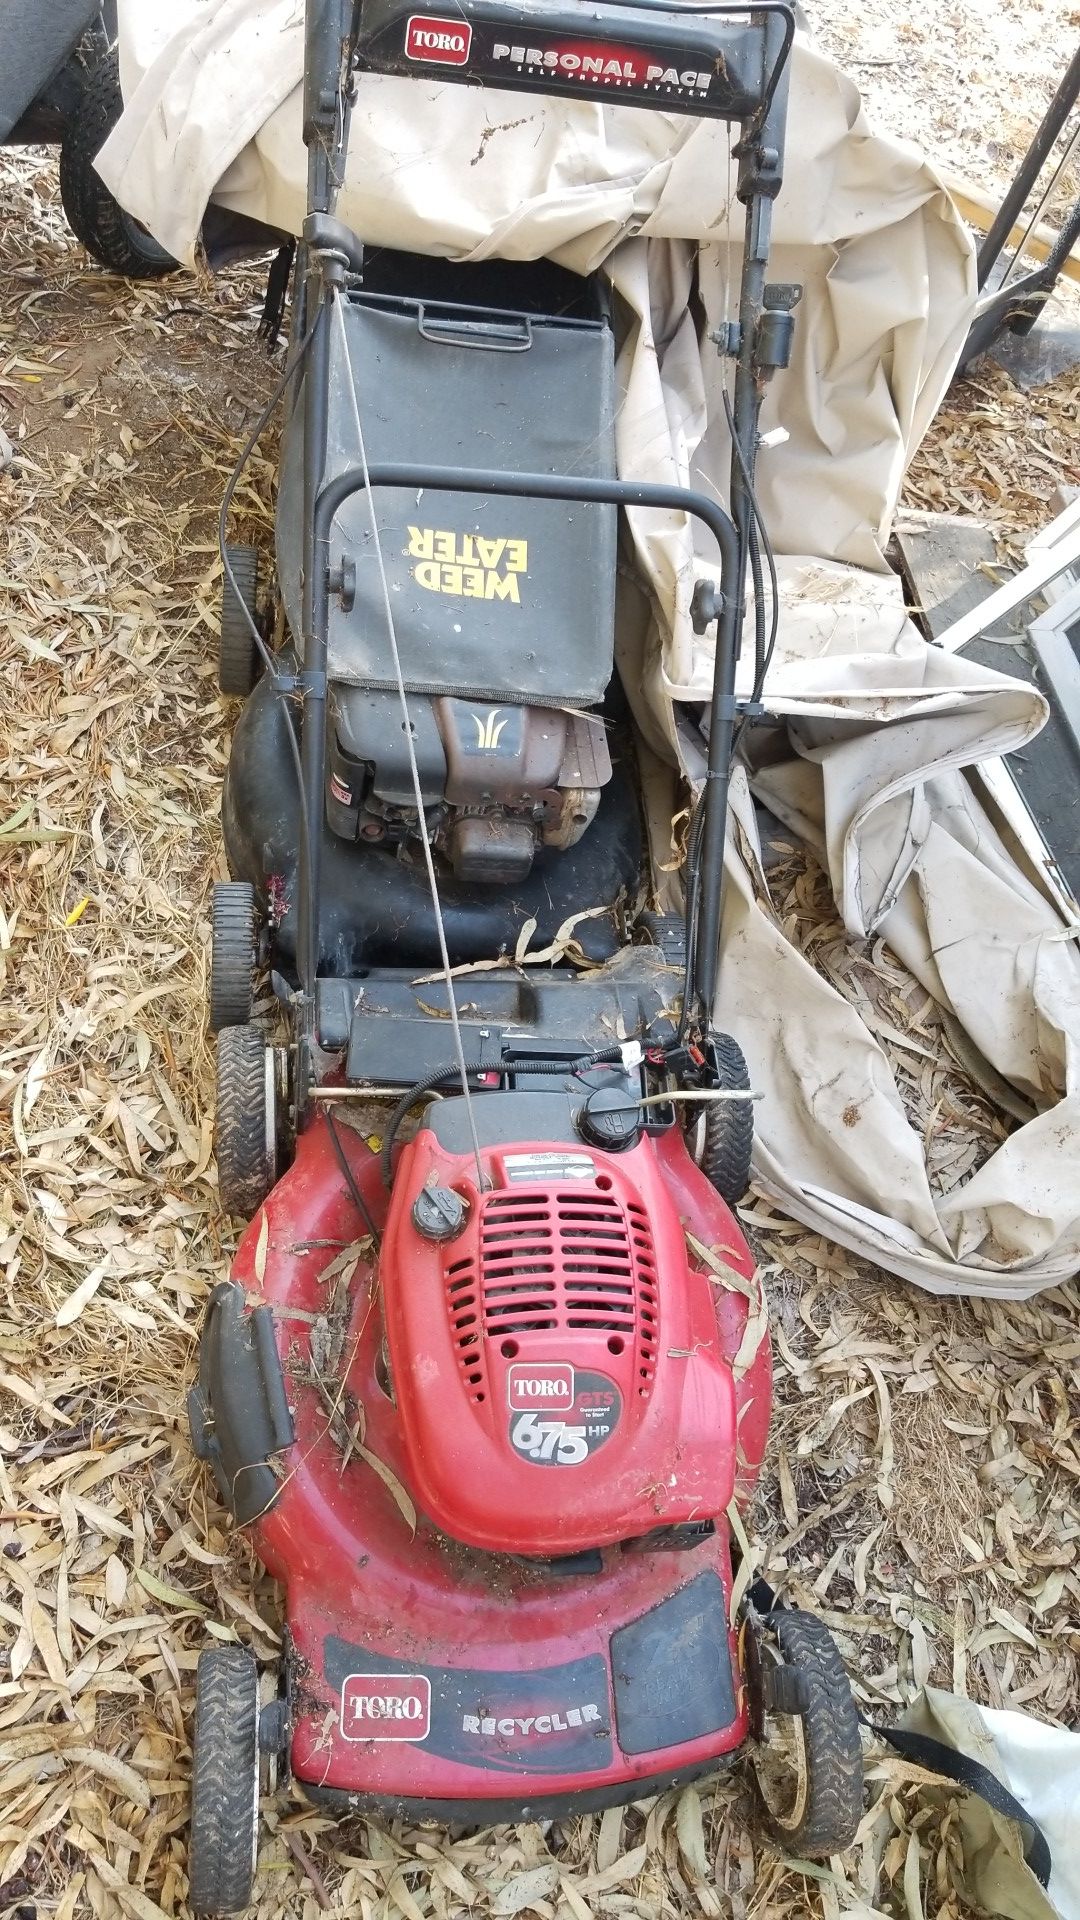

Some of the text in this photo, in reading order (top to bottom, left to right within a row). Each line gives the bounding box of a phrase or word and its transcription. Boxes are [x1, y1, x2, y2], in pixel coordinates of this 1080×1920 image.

[493, 44, 712, 89] PERSONAL PACE
[516, 65, 708, 98] SELF PROPEL SYSTEM
[407, 526, 528, 573] EATER
[414, 561, 521, 604] WEED
[575, 1391, 615, 1406] GTS
[588, 1425, 610, 1437] HP
[462, 1703, 602, 1737] RECYCLER
